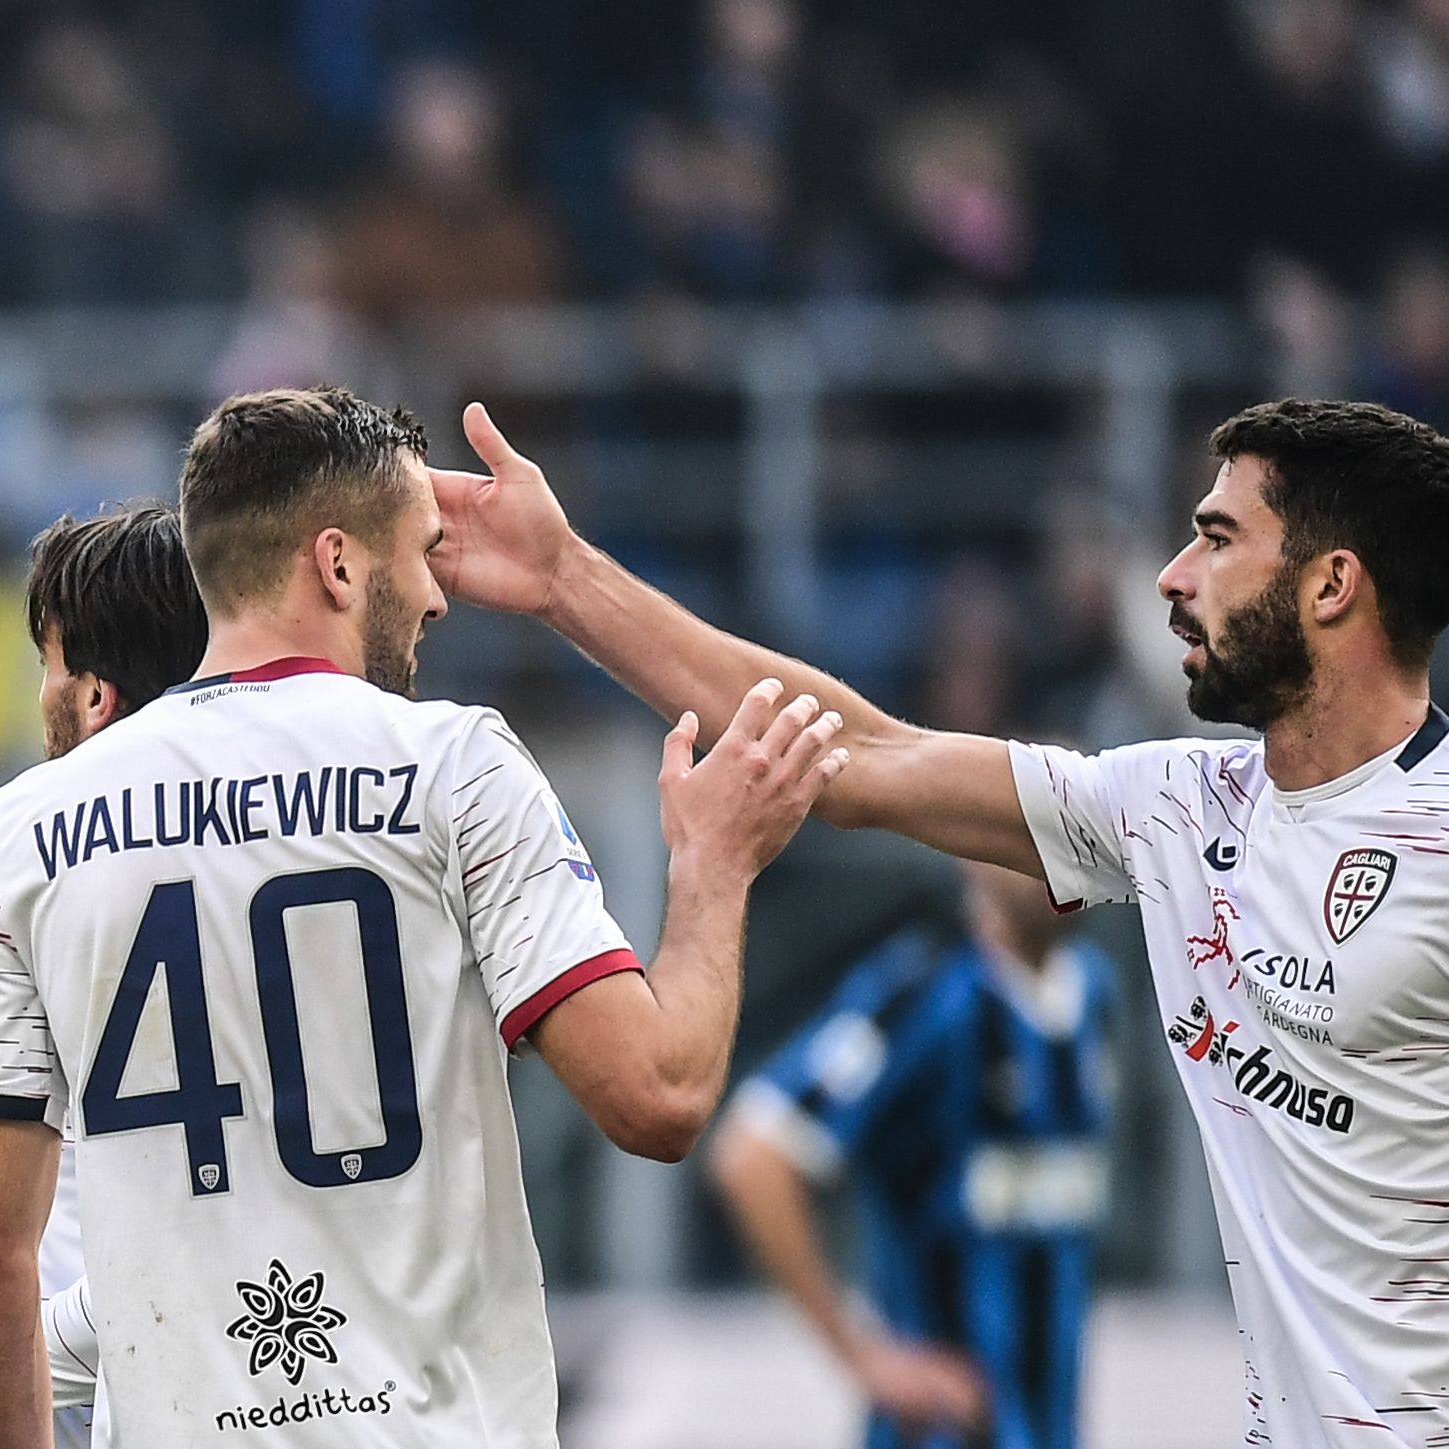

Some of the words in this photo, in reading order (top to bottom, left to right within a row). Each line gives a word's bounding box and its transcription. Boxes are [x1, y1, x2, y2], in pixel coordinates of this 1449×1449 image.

[33, 762, 422, 881] WALUKIEWICZ
[1343, 852, 1392, 871] CAGLIARI
[82, 866, 424, 1198] 40
[1257, 1004, 1334, 1047] ARDEGNA
